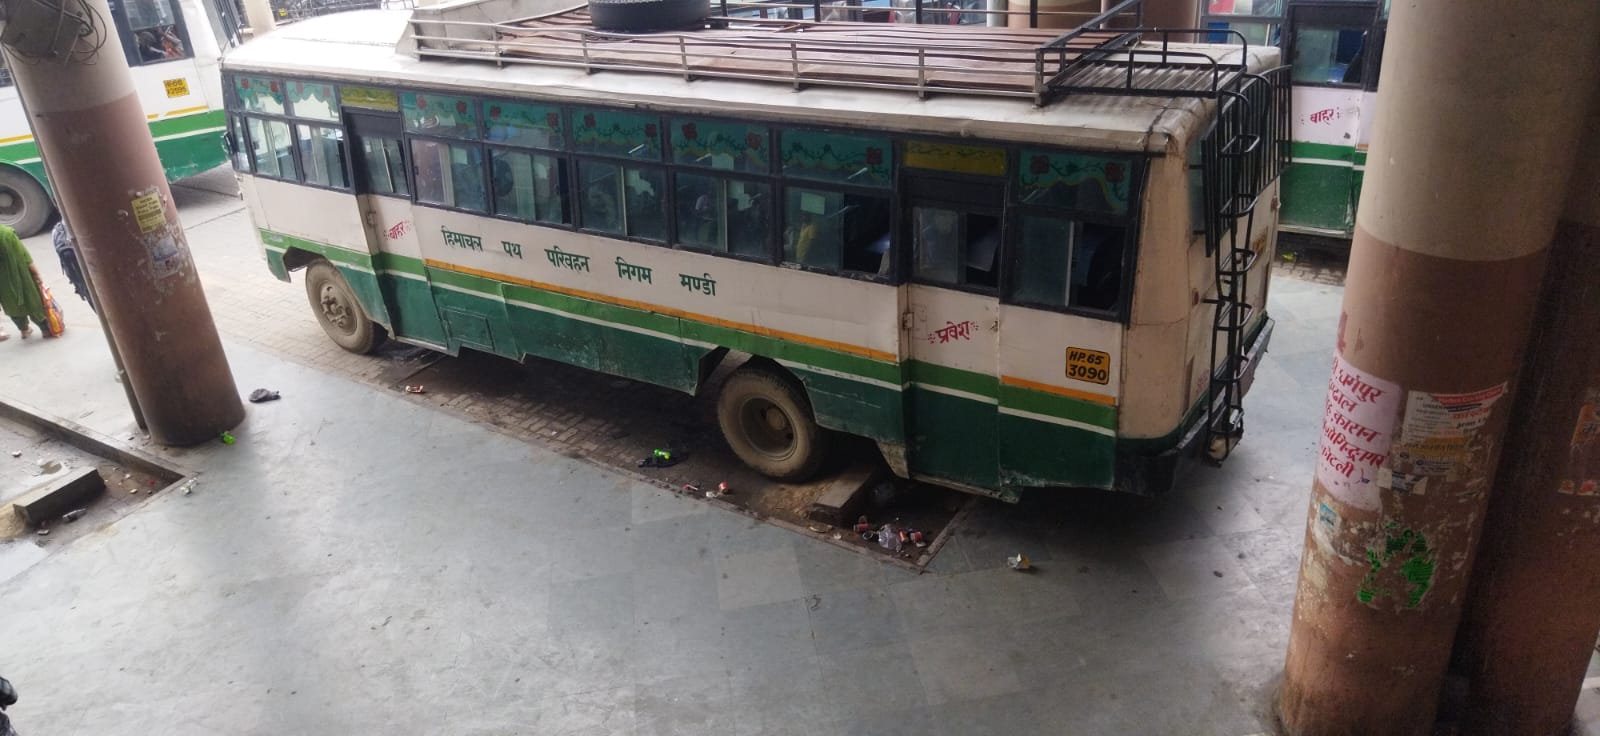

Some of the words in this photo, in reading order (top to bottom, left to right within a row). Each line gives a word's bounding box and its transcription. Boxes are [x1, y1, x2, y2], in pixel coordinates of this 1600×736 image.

[441, 225, 483, 251] हिमाचल
[501, 241, 523, 259] पथ
[544, 246, 590, 272] परिवहन
[615, 256, 653, 284] निगम
[679, 272, 717, 296] मण्डी
[935, 321, 970, 343] प्रवेश
[1069, 364, 1107, 381] 3090
